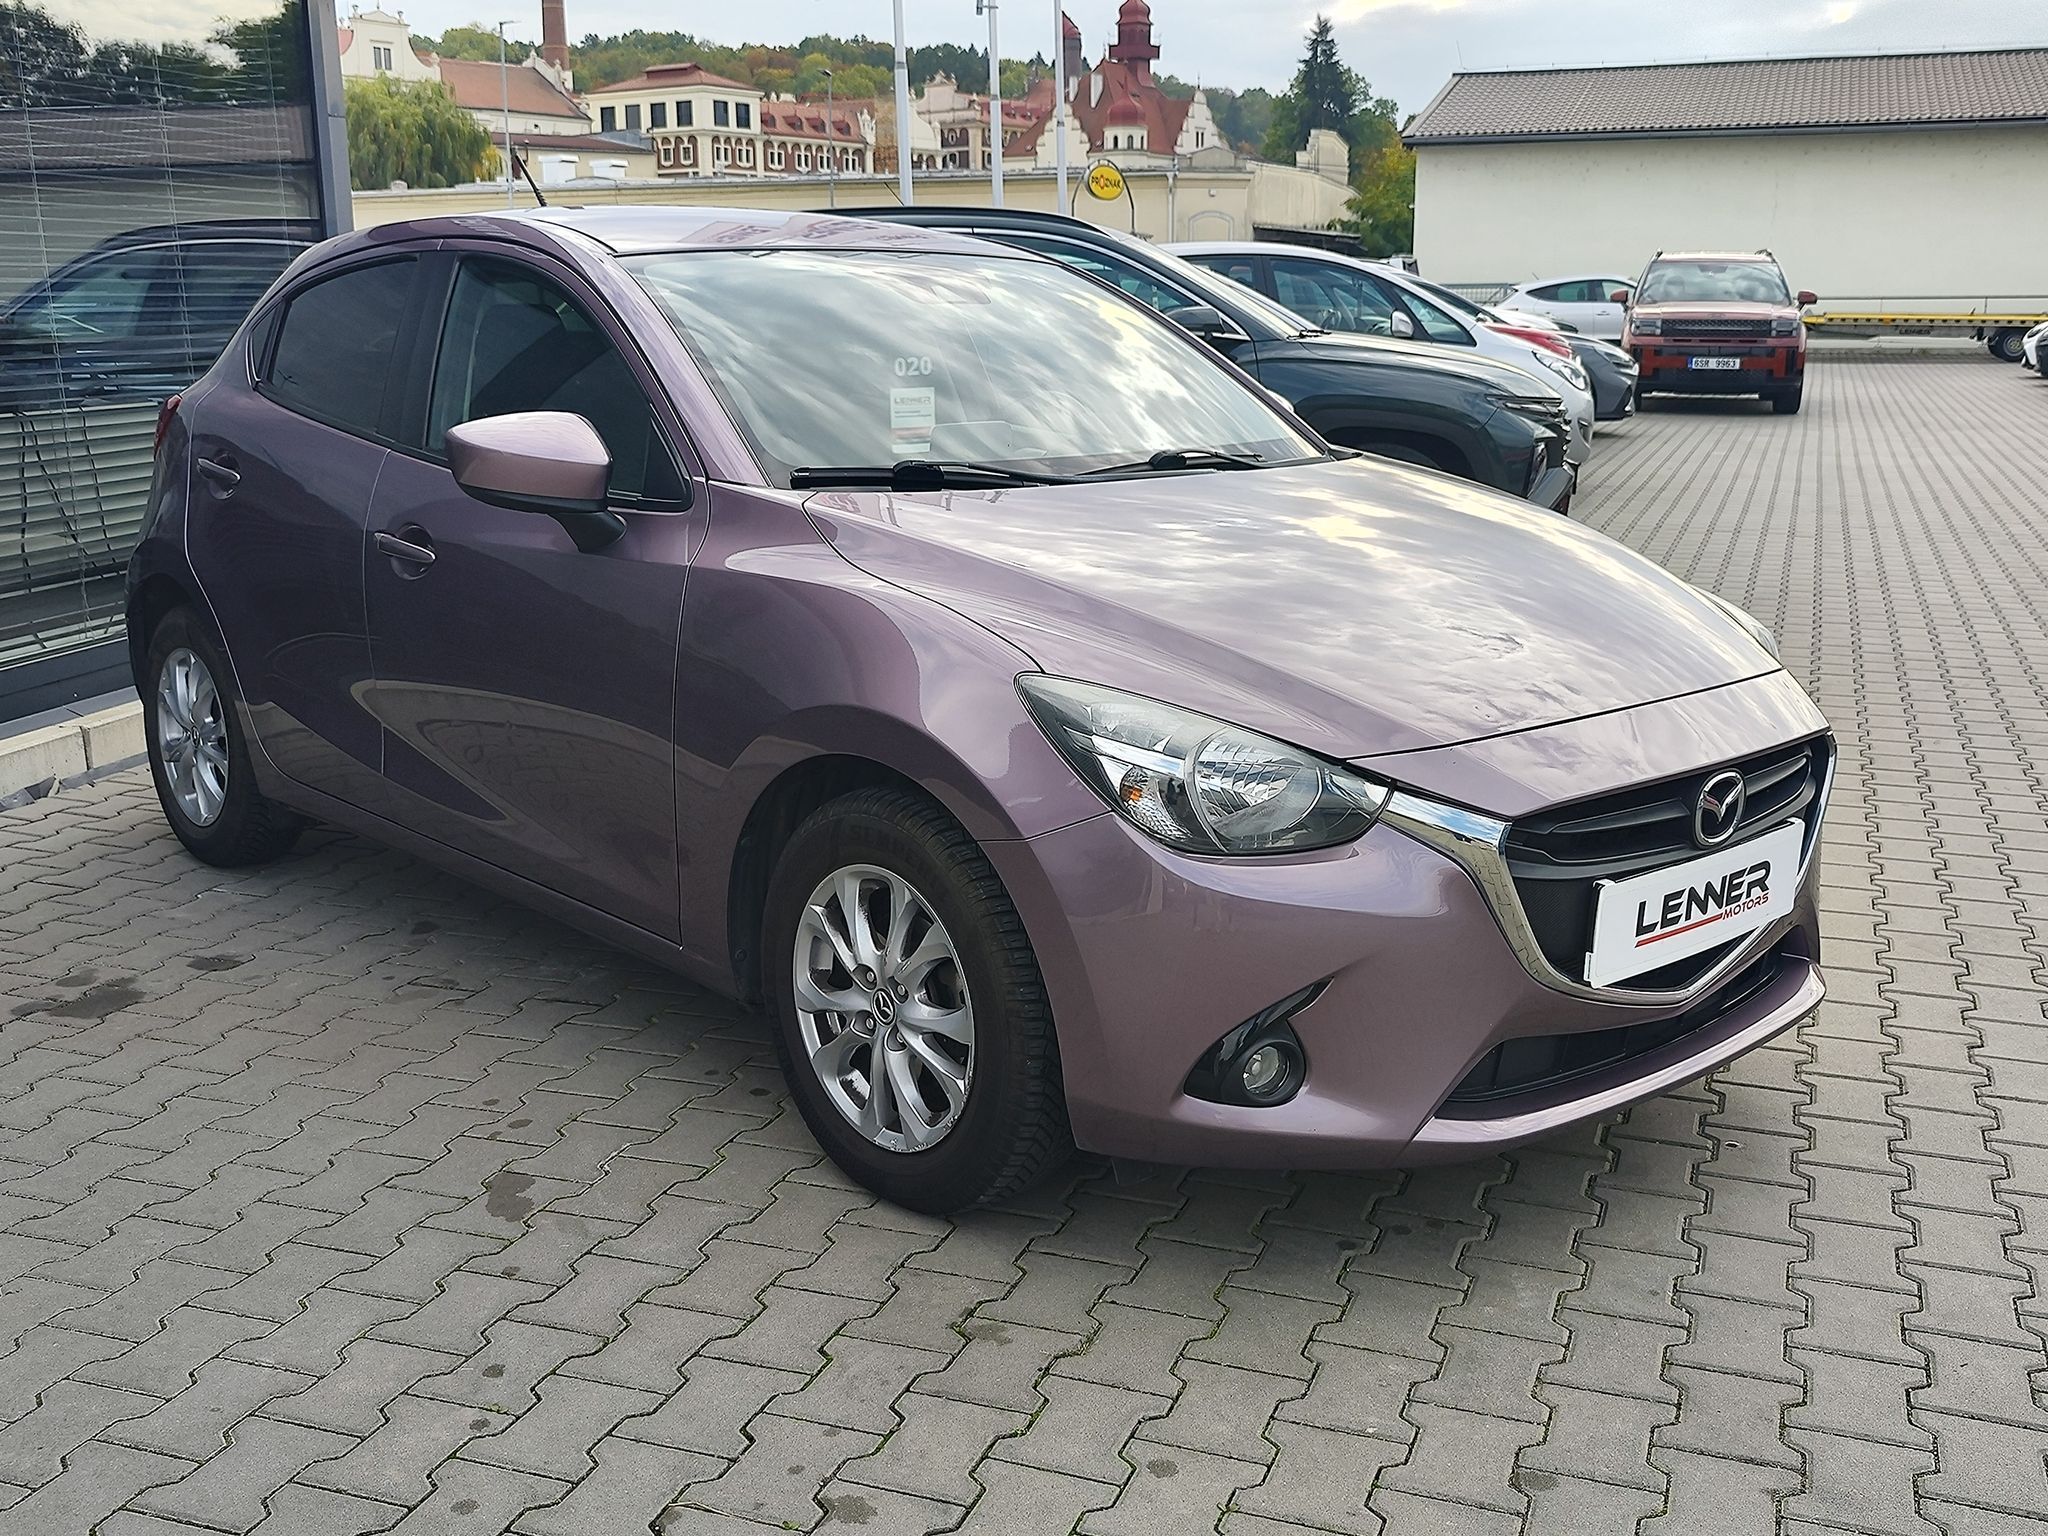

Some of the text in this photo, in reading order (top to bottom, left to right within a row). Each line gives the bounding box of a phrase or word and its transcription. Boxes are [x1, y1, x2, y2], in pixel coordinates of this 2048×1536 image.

[895, 356, 932, 377] 020
[1635, 860, 1771, 937] LENNER
[1722, 892, 1769, 920] MOTORS
